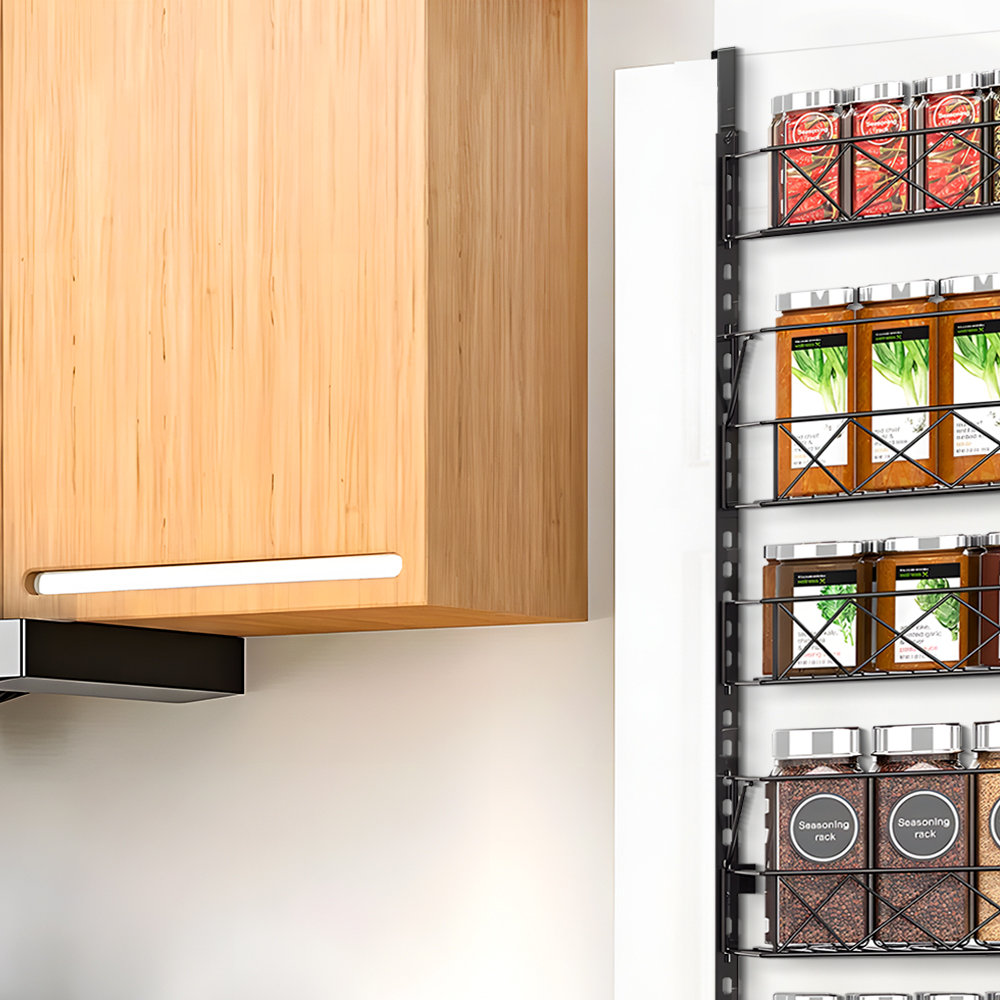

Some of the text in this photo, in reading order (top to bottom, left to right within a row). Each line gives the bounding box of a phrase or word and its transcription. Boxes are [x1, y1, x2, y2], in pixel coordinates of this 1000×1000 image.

[798, 820, 850, 831] Seasoning
[898, 817, 951, 829] Seasoning
[814, 832, 836, 842] rack
[914, 829, 937, 839] rack
